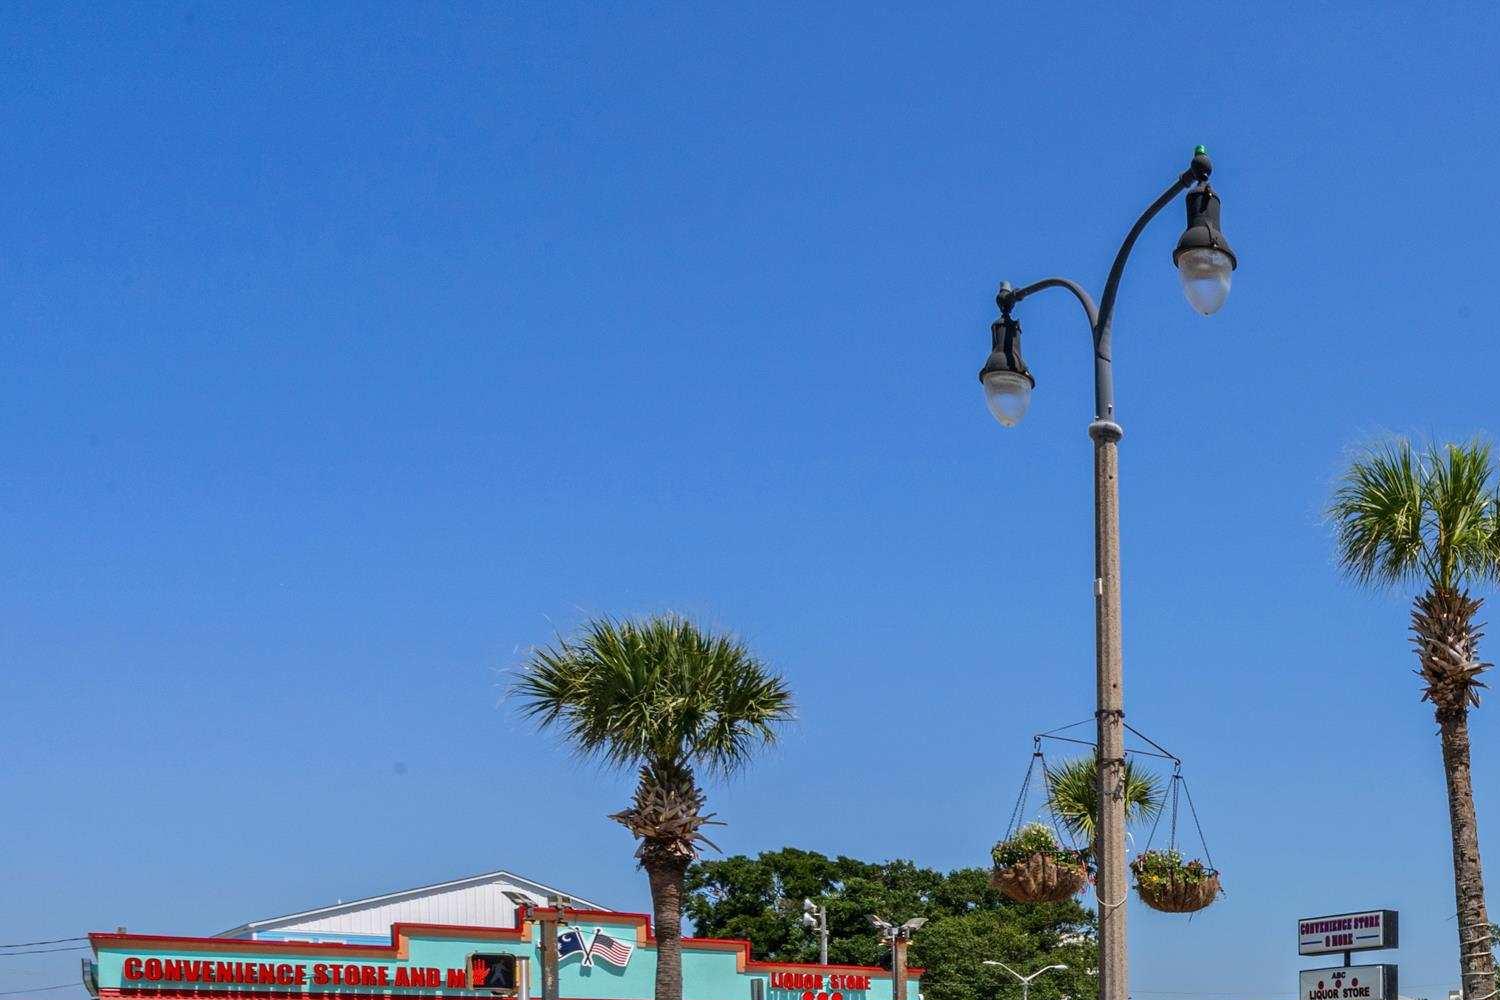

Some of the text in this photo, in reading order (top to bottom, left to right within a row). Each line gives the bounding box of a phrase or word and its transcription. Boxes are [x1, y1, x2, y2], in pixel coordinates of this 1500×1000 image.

[1301, 914, 1380, 936] CONVENIENCE STORE
[1332, 933, 1353, 947] MORE
[124, 957, 307, 986] CONVENIENCE
[313, 963, 390, 987] STORE
[395, 966, 441, 988] AND
[1332, 971, 1346, 979] ABC
[771, 972, 871, 991] LIQUOR STORE
[1309, 986, 1370, 1000] LIQUOR STORE
